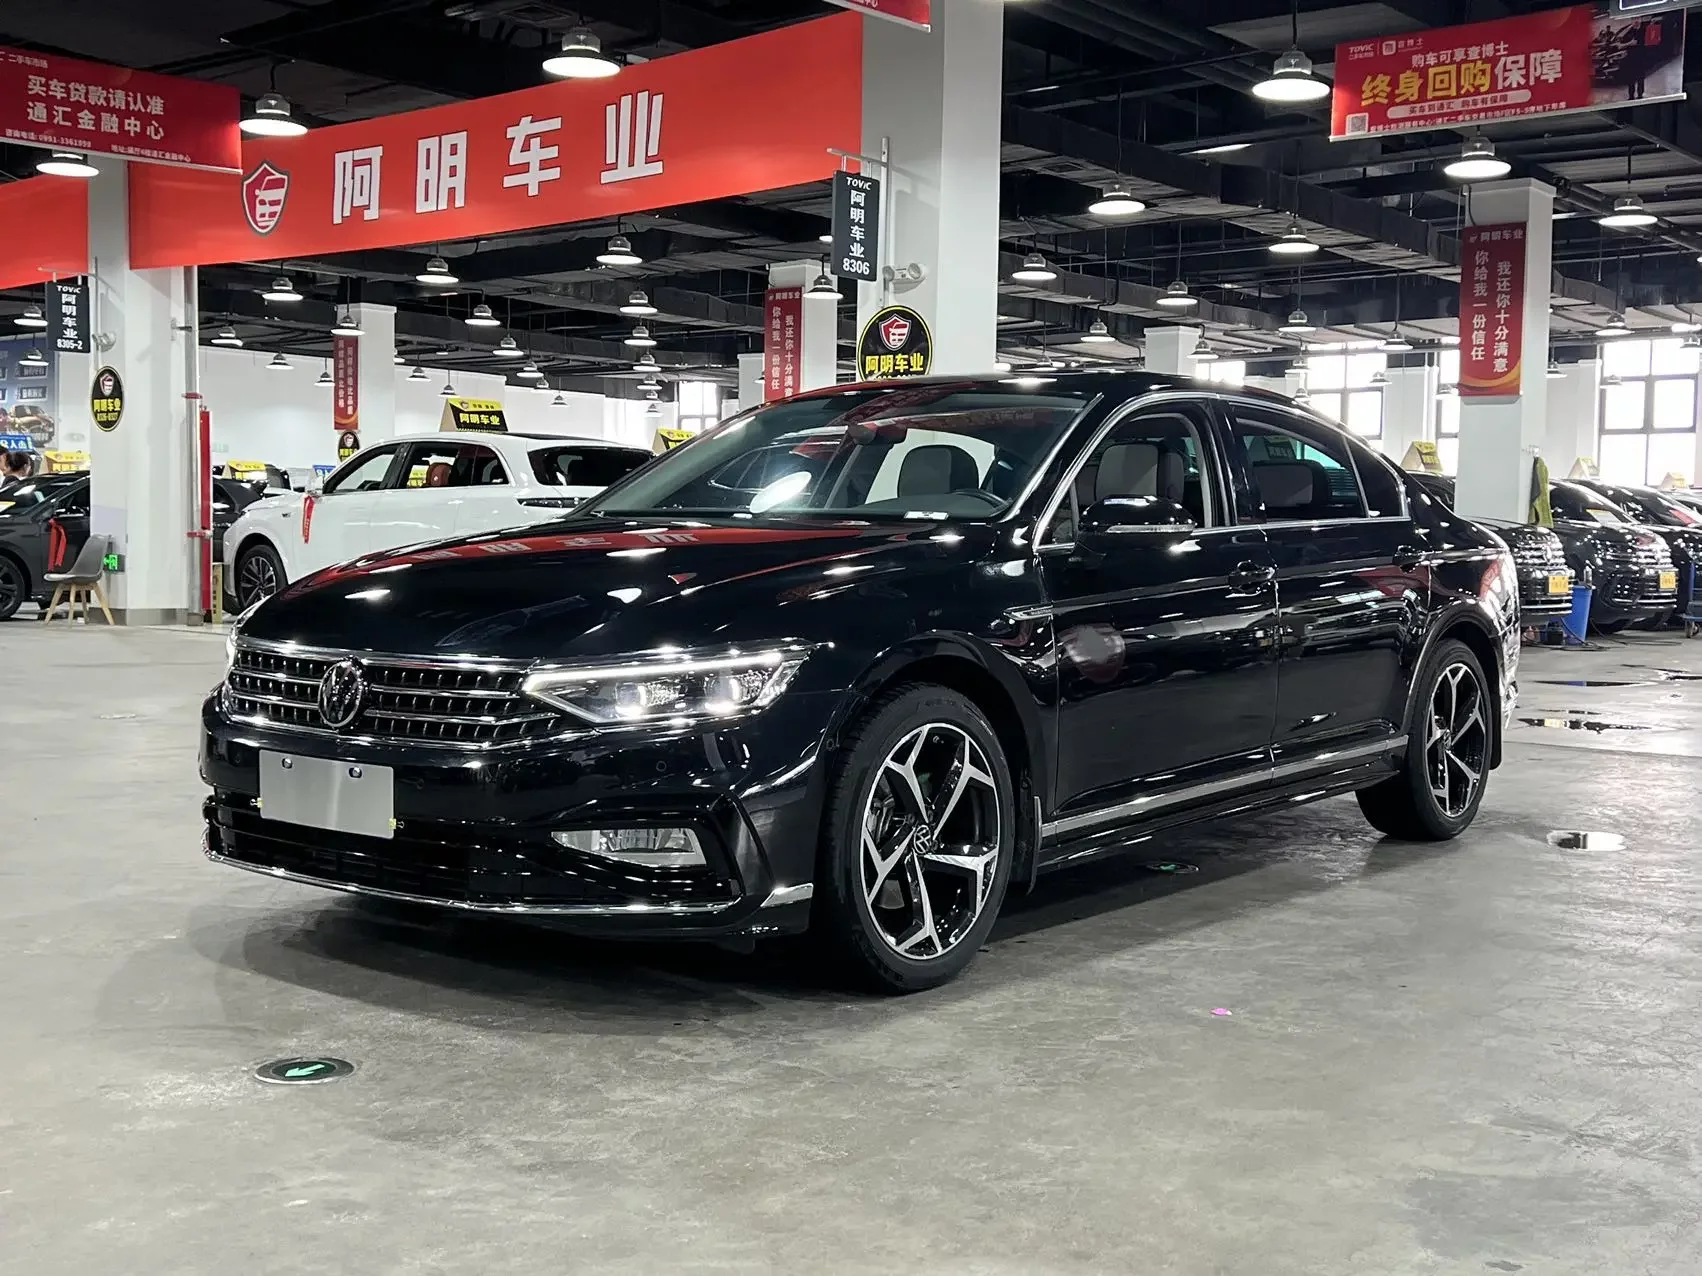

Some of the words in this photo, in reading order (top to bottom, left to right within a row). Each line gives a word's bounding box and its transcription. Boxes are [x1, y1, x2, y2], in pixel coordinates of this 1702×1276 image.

[1411, 41, 1509, 69] 购车可享查博士
[28, 75, 164, 116] 买车贷款请认准
[1360, 49, 1562, 107] 终身回购保障
[27, 102, 164, 140] 通汇金融中心
[332, 90, 664, 225] 阿明车业
[849, 190, 865, 258] 阿明车业
[842, 257, 870, 275] 8306
[61, 293, 78, 339] 阿明车业
[1471, 250, 1489, 361] 你给我一份信任
[1493, 261, 1512, 373] 我还你十分满意
[56, 338, 83, 350] 8305-2
[771, 306, 781, 390] 你给我一份信任
[865, 353, 924, 374] 阿明车业
[459, 413, 500, 425] 阿明车业
